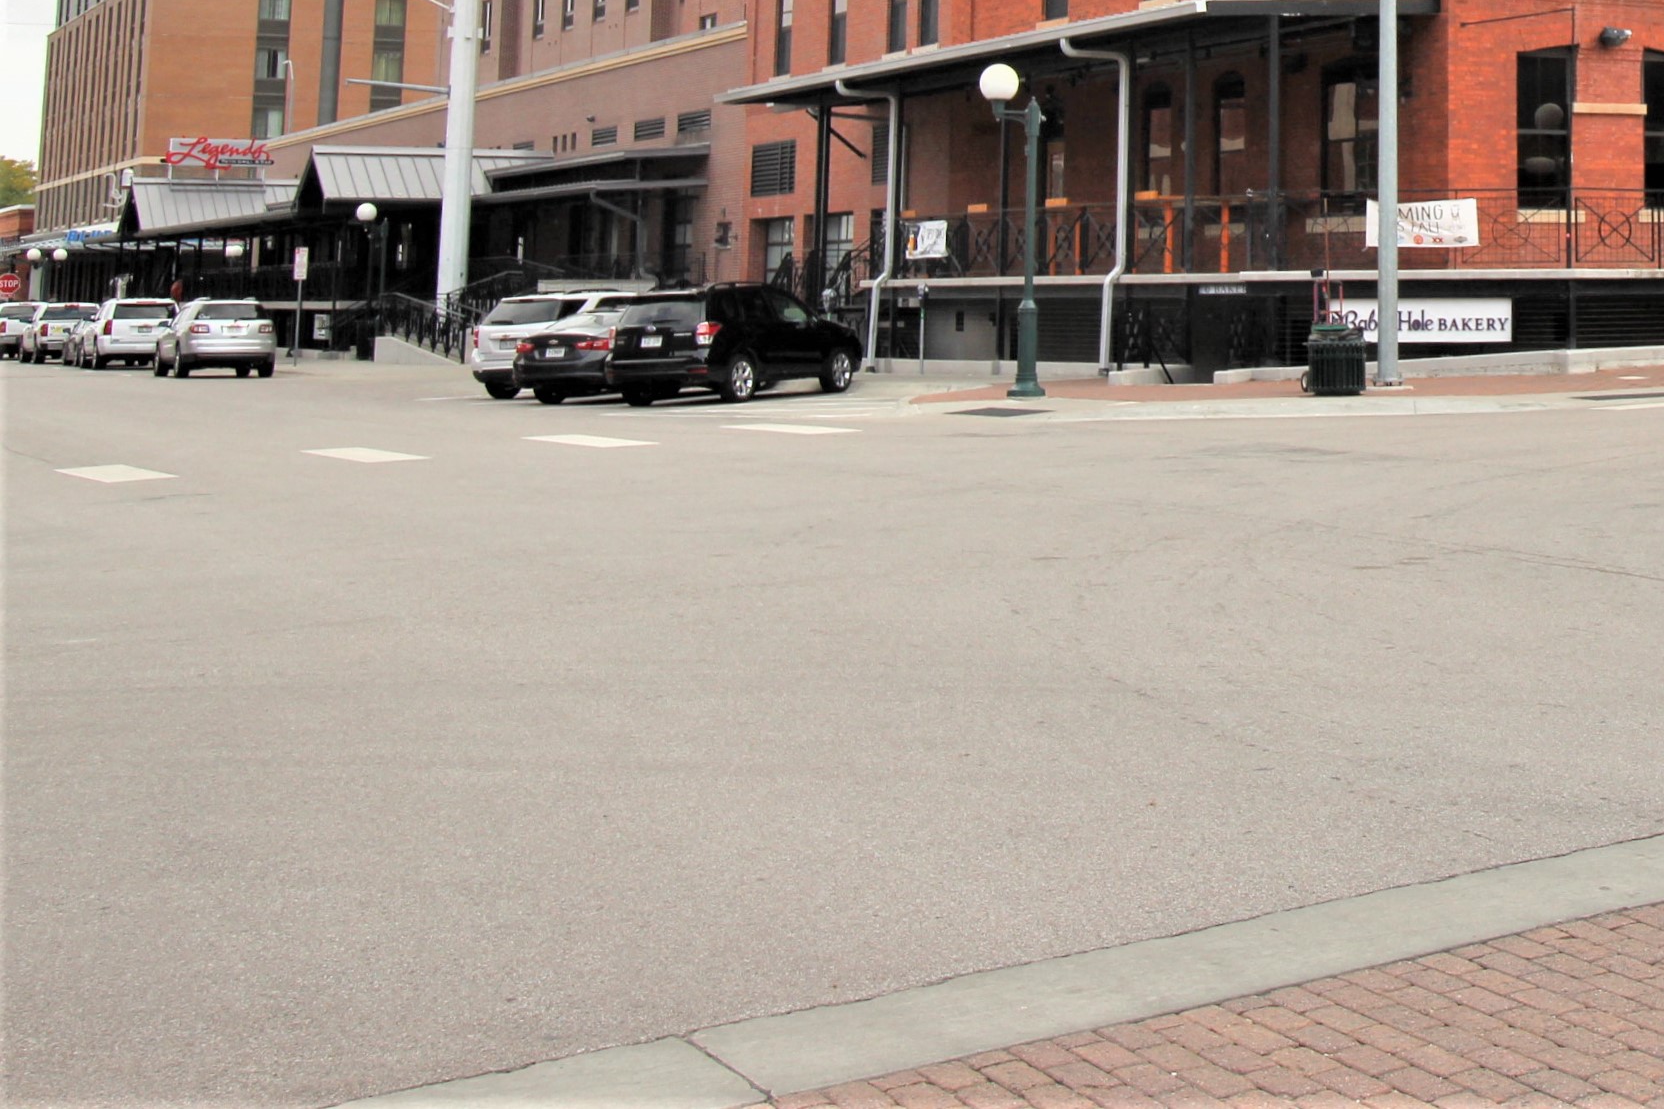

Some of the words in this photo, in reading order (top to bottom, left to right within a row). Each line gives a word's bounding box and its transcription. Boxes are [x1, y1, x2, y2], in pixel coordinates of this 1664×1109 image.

[166, 136, 271, 170] Legends
[0, 279, 19, 288] STOP
[1397, 309, 1434, 332] Hole
[1438, 317, 1509, 332] BAKERY
